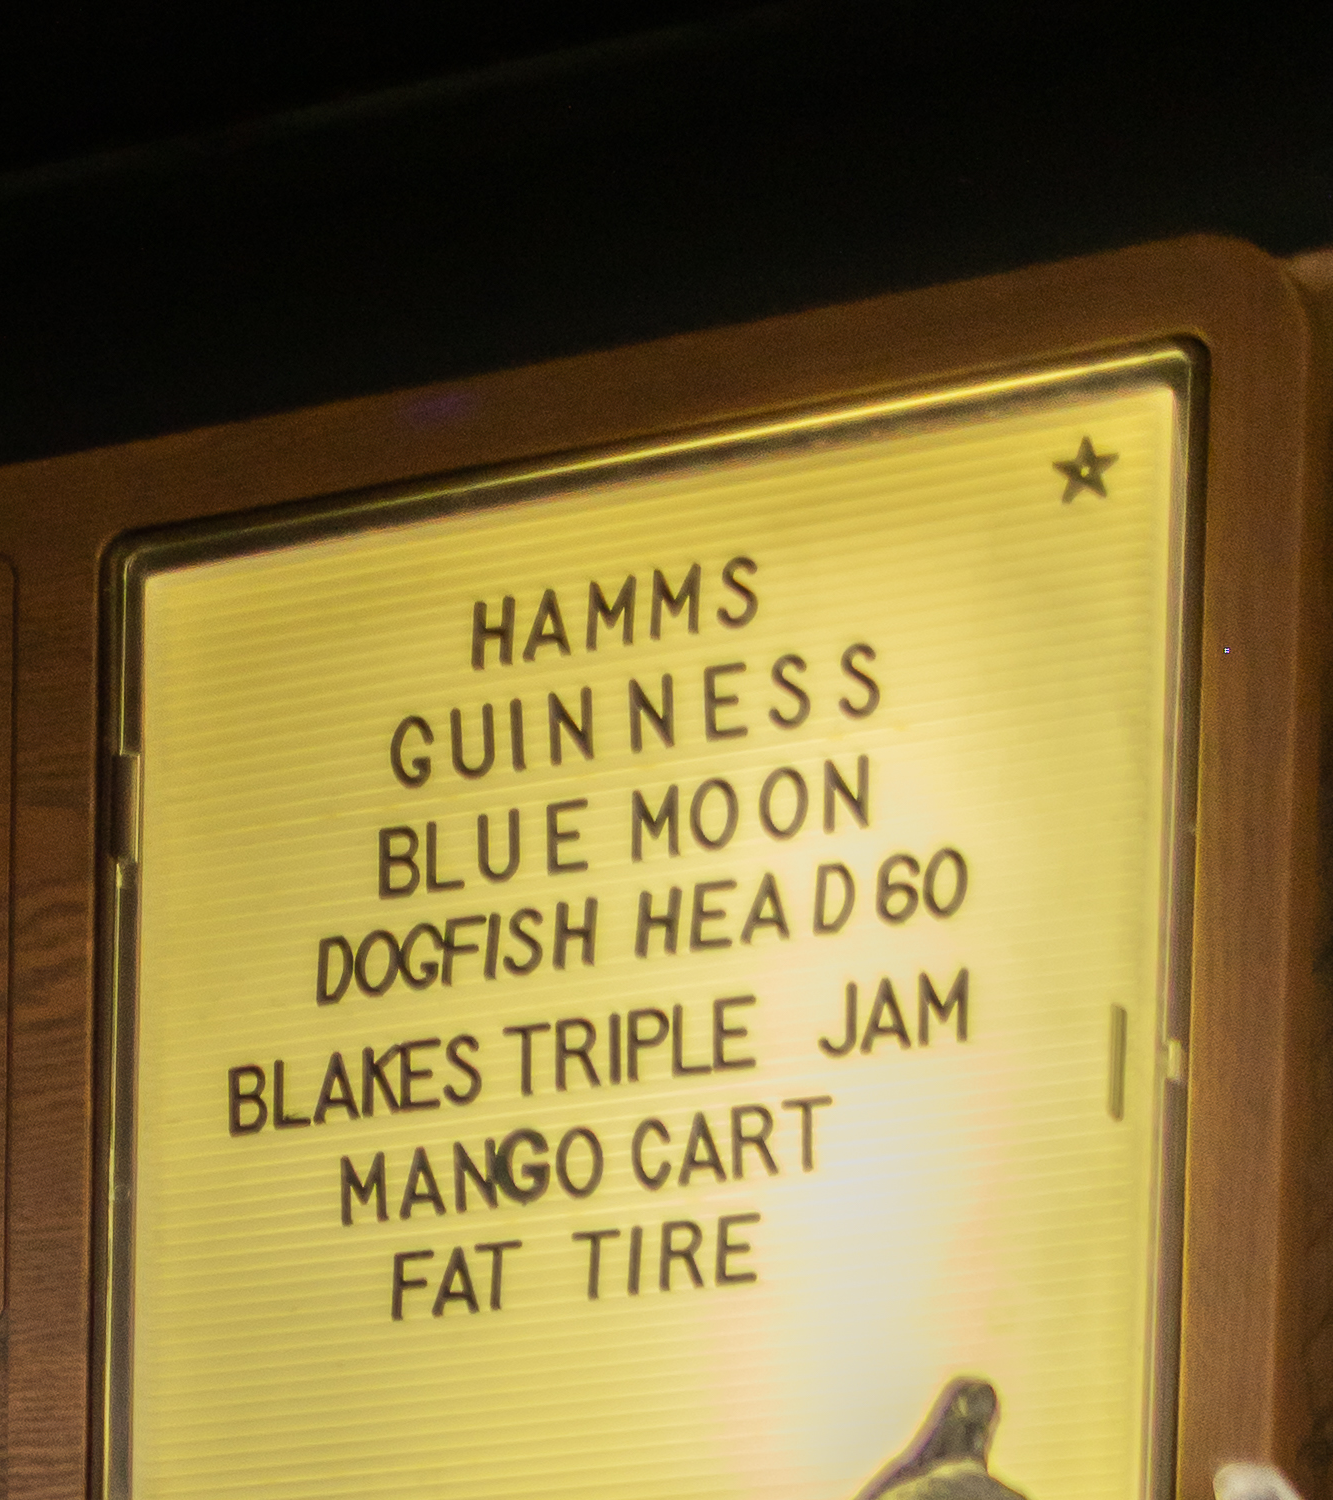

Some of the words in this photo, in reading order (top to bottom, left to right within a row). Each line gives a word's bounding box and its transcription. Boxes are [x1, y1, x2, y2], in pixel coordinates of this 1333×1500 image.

[470, 556, 759, 671] HAMMS
[390, 643, 879, 787] GUINNESS
[378, 799, 589, 898] BLUE
[631, 754, 870, 864] MOON
[316, 897, 597, 1007] DOGFISH
[227, 1034, 483, 1136] BLAKES
[504, 995, 757, 1096] TRIPLE
[818, 967, 970, 1058] JAM
[340, 1126, 604, 1226] MANGO
[633, 1096, 832, 1192] CART
[392, 1240, 522, 1321] FAT
[573, 1212, 760, 1300] TIRE
